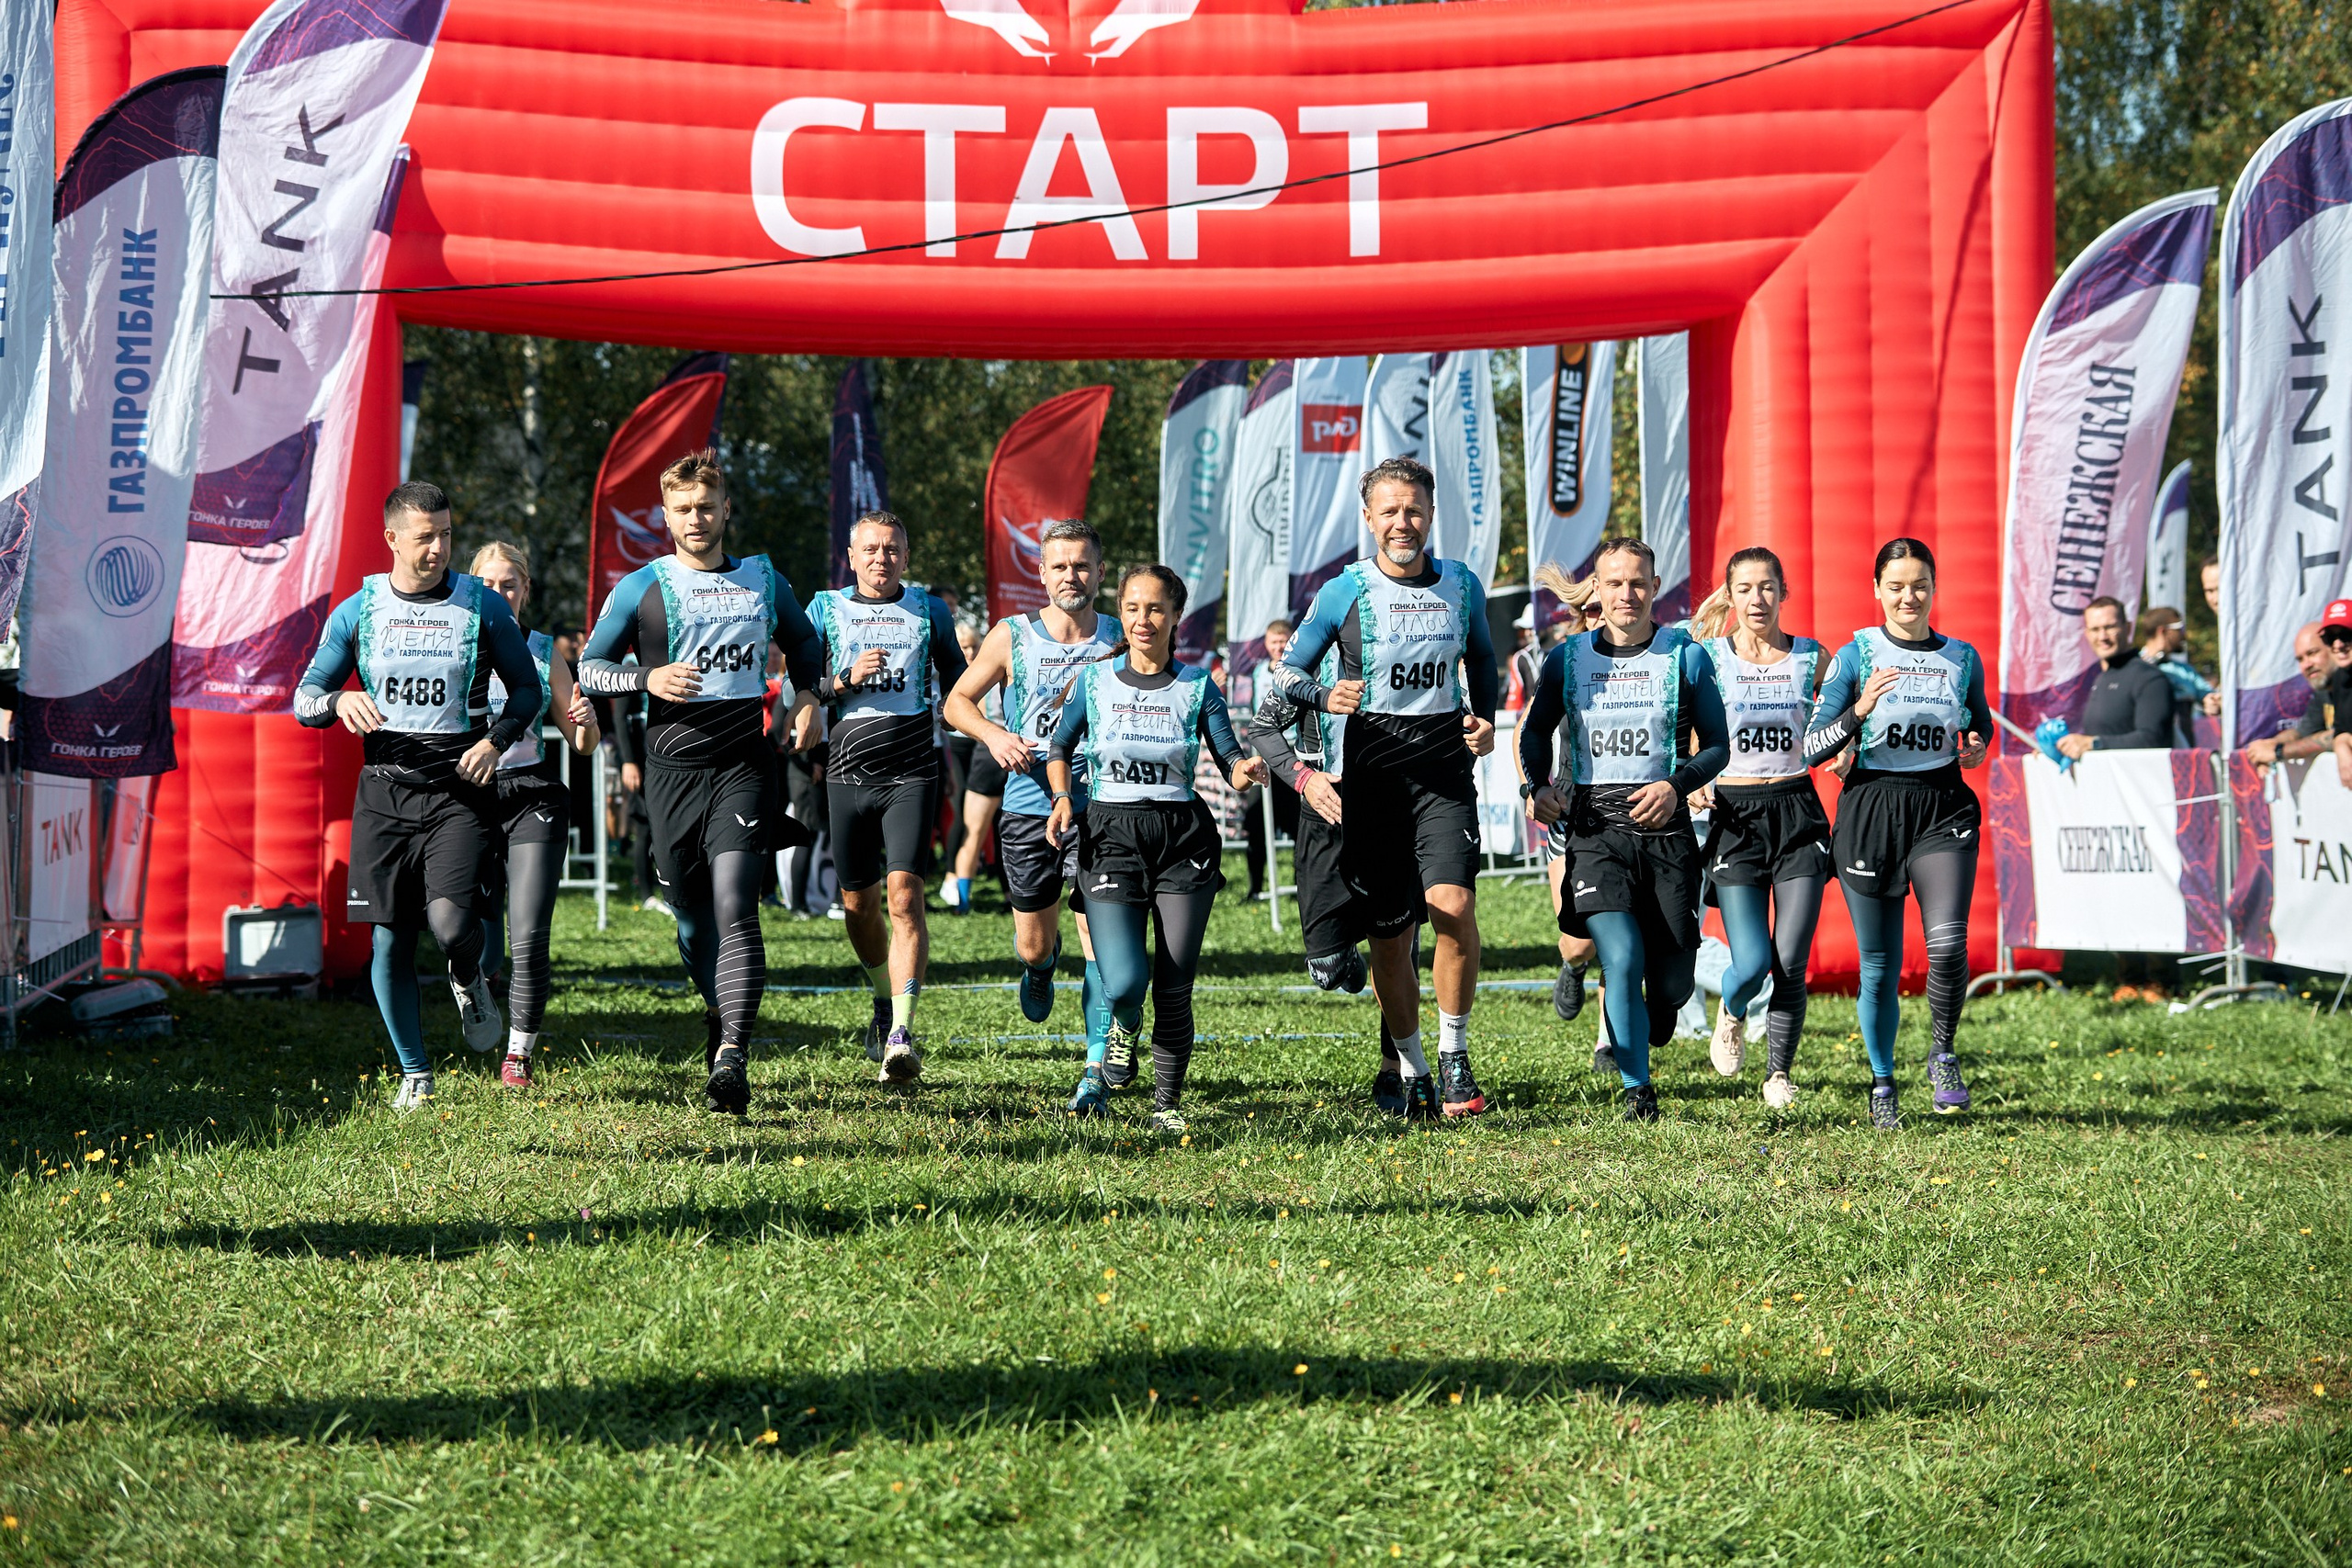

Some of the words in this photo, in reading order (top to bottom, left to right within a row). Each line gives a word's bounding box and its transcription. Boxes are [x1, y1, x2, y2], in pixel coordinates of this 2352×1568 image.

[750, 96, 1429, 261] СТАРТ
[232, 103, 346, 396] TANK
[107, 228, 158, 513] ГАЗПРОМБАНК
[1554, 368, 1582, 502] WINLINE
[1458, 368, 1484, 527] ГАЗПРОМБАНК
[2288, 293, 2340, 597] TANK
[2050, 360, 2137, 616] СЕНЕЖСКАЯ
[1184, 426, 1220, 581] INVITRO
[229, 517, 271, 530] ГЕРОЕВ
[692, 587, 719, 595] ГОНКА
[710, 615, 762, 625] ГАЗПРОМБАНК
[846, 624, 920, 644] СЛАВА
[1406, 633, 1455, 642] ГАЗПРОМБАНК
[400, 649, 454, 658] ГАЗПРОМБАНК
[864, 642, 912, 650] ГАЗПРОМБАНК
[697, 641, 755, 675] 6494
[1390, 661, 1447, 691] 6490
[1590, 671, 1617, 680] ГОНКА
[1619, 671, 1650, 679] ГЕРОЕВ
[1918, 666, 1948, 675] ГЕРОЕВ
[203, 681, 242, 694] ГОНКА
[243, 683, 287, 696] ГЕРОЕВ
[852, 668, 906, 694] 493
[1896, 674, 1947, 693] ЛЕСЯ
[385, 677, 446, 706] 6488
[1743, 682, 1796, 700] ЛЕНА
[1904, 695, 1953, 706] ГАЗПРОМБАНК
[1112, 703, 1137, 711] ГОНКА
[1138, 705, 1171, 713] ГЕРОЕВ
[1601, 700, 1655, 710] ГАЗПРОМБАНК
[1749, 702, 1798, 711] ГАЗПРОМБАНК
[1121, 733, 1176, 744] ГАЗПРОМБАНК
[1591, 728, 1650, 758] 6492
[1736, 727, 1793, 753] 6498
[1886, 723, 1946, 751] 6496
[51, 742, 97, 757] ГОНКА
[100, 744, 142, 759] ГЕРОЕВ
[1110, 760, 1170, 785] 6497
[41, 807, 85, 866] TANK
[1376, 909, 1410, 927] GIVOVA
